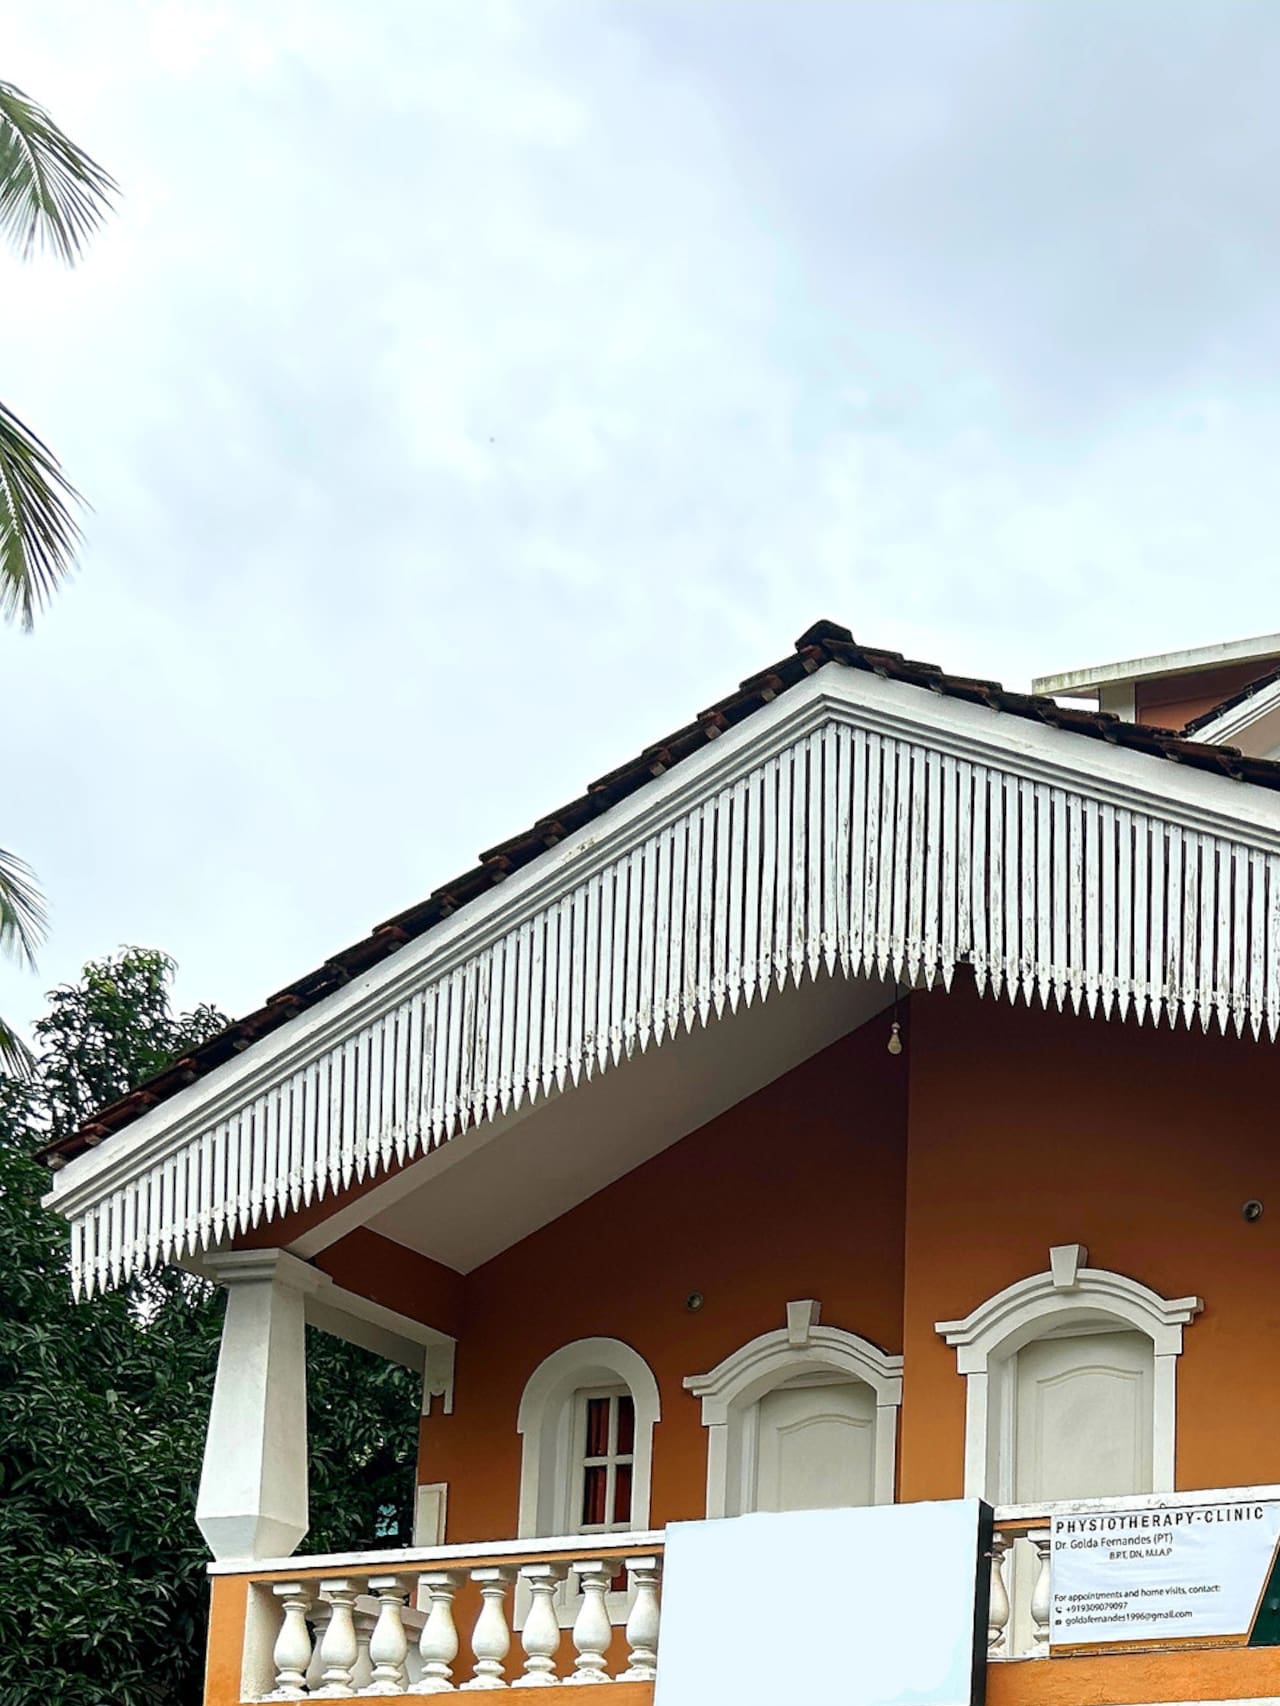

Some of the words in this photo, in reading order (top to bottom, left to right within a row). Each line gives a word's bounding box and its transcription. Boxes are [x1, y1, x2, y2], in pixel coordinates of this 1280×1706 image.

[1055, 1506, 1264, 1534] PHYSIOTHERAPY-CLINIC
[1070, 1538, 1098, 1549] Golda
[1100, 1534, 1151, 1547] Fernandes
[1153, 1532, 1174, 1545] (PT)
[1054, 1594, 1066, 1602] For
[1068, 1591, 1123, 1602] appointments
[1124, 1588, 1139, 1598] and
[1141, 1587, 1164, 1596] home
